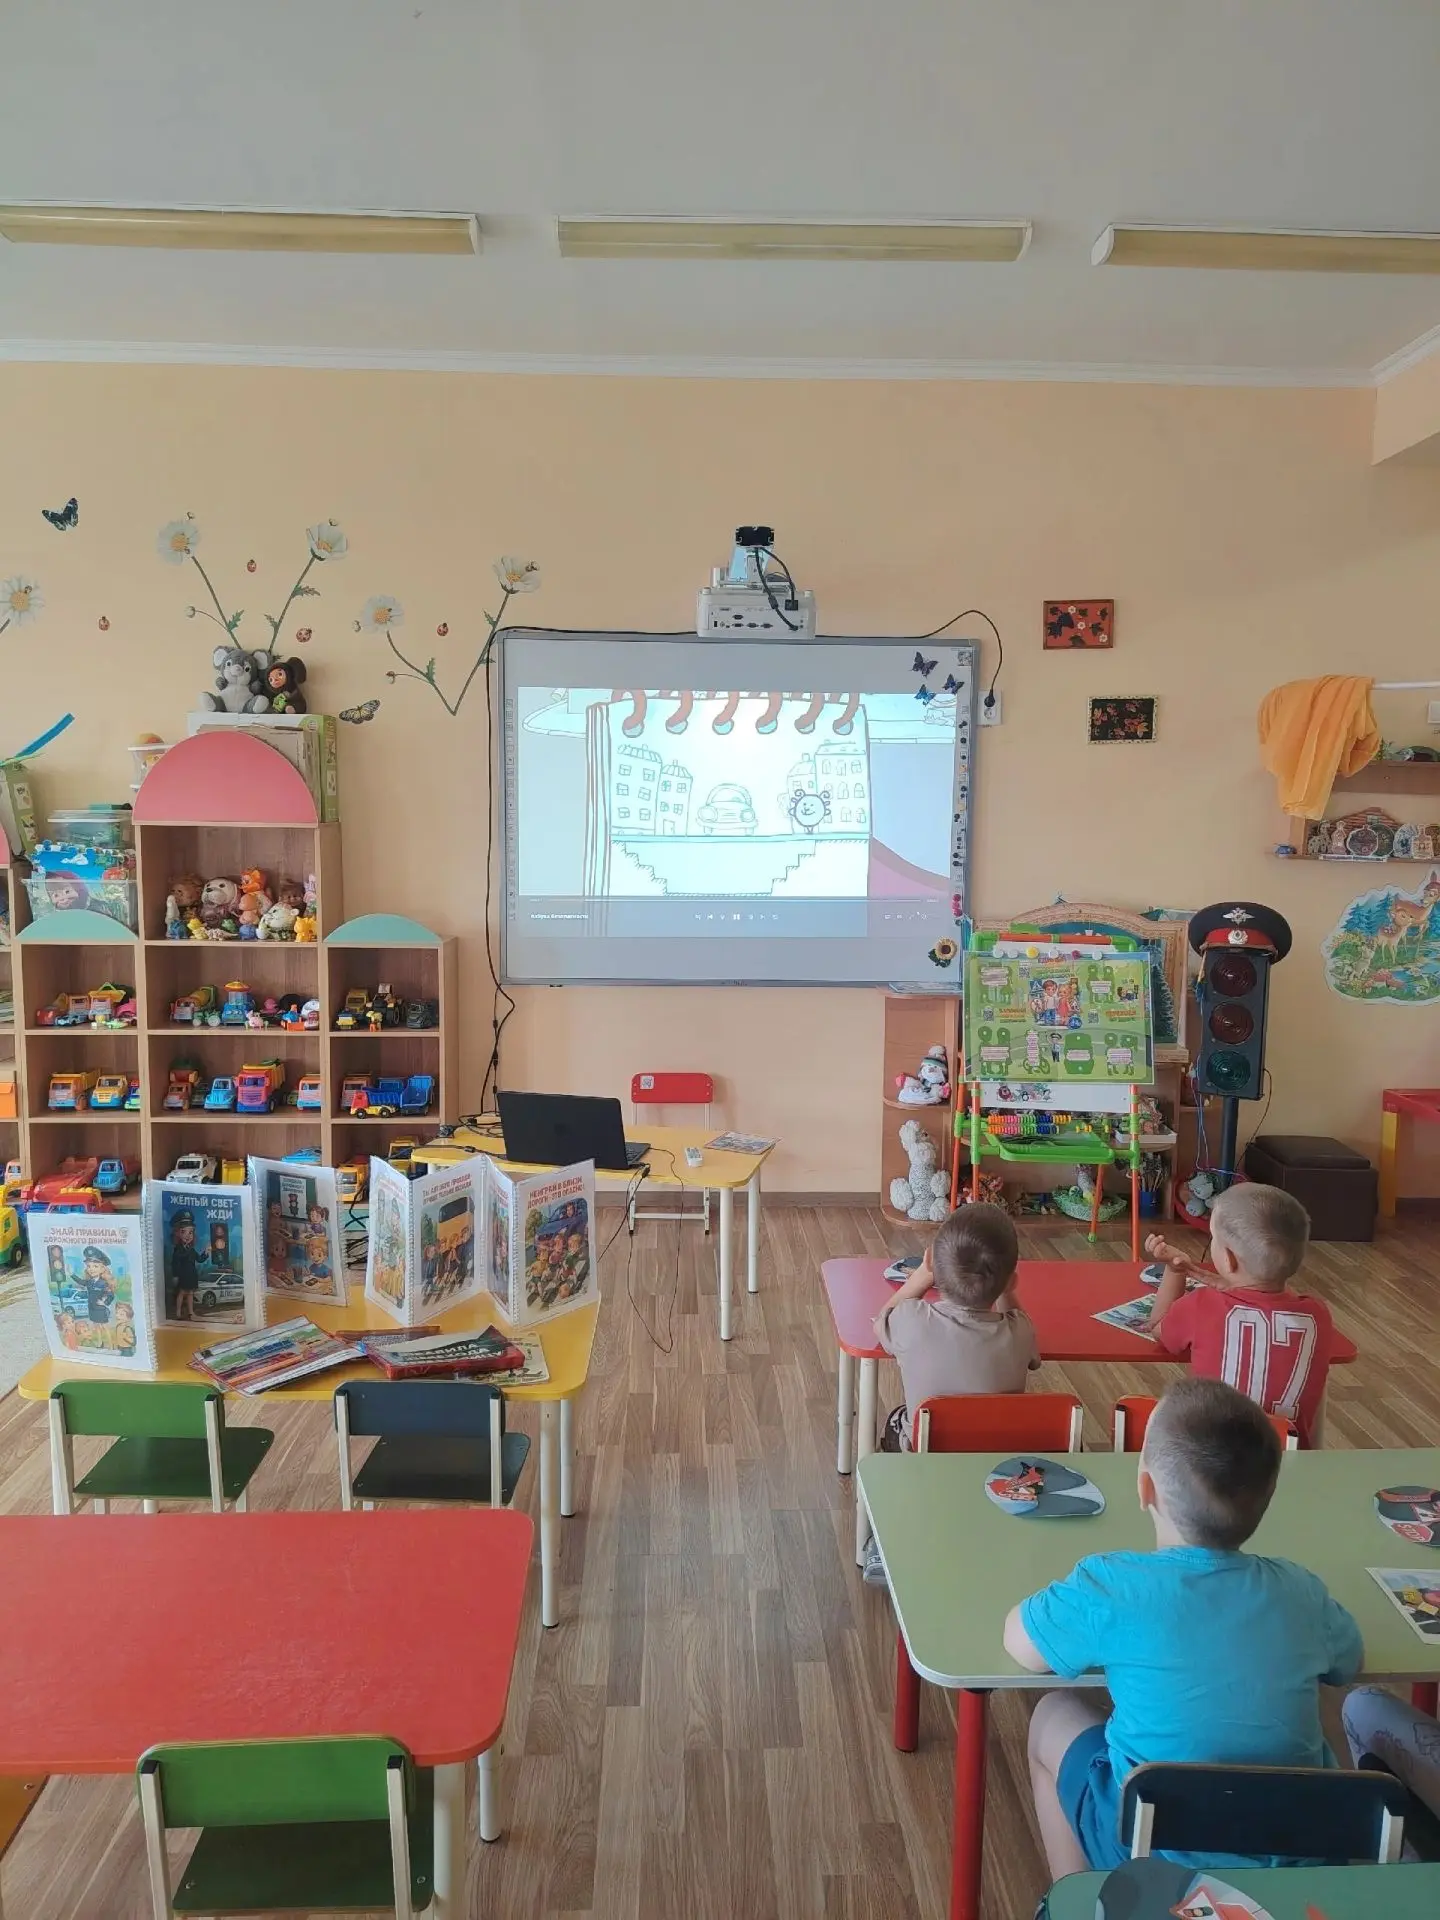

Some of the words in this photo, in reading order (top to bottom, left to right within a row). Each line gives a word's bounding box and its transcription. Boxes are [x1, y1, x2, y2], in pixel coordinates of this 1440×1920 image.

[206, 1209, 233, 1220] ЖДИ
[50, 1226, 74, 1236] ЗНАЙ
[76, 1228, 117, 1237] ПРАВИЛА
[44, 1236, 87, 1244] ДОРОЖНОГО
[88, 1237, 127, 1245] ДВИЖЕНИЯ
[1221, 1305, 1317, 1421] 07
[1397, 1523, 1426, 1541] STOP
